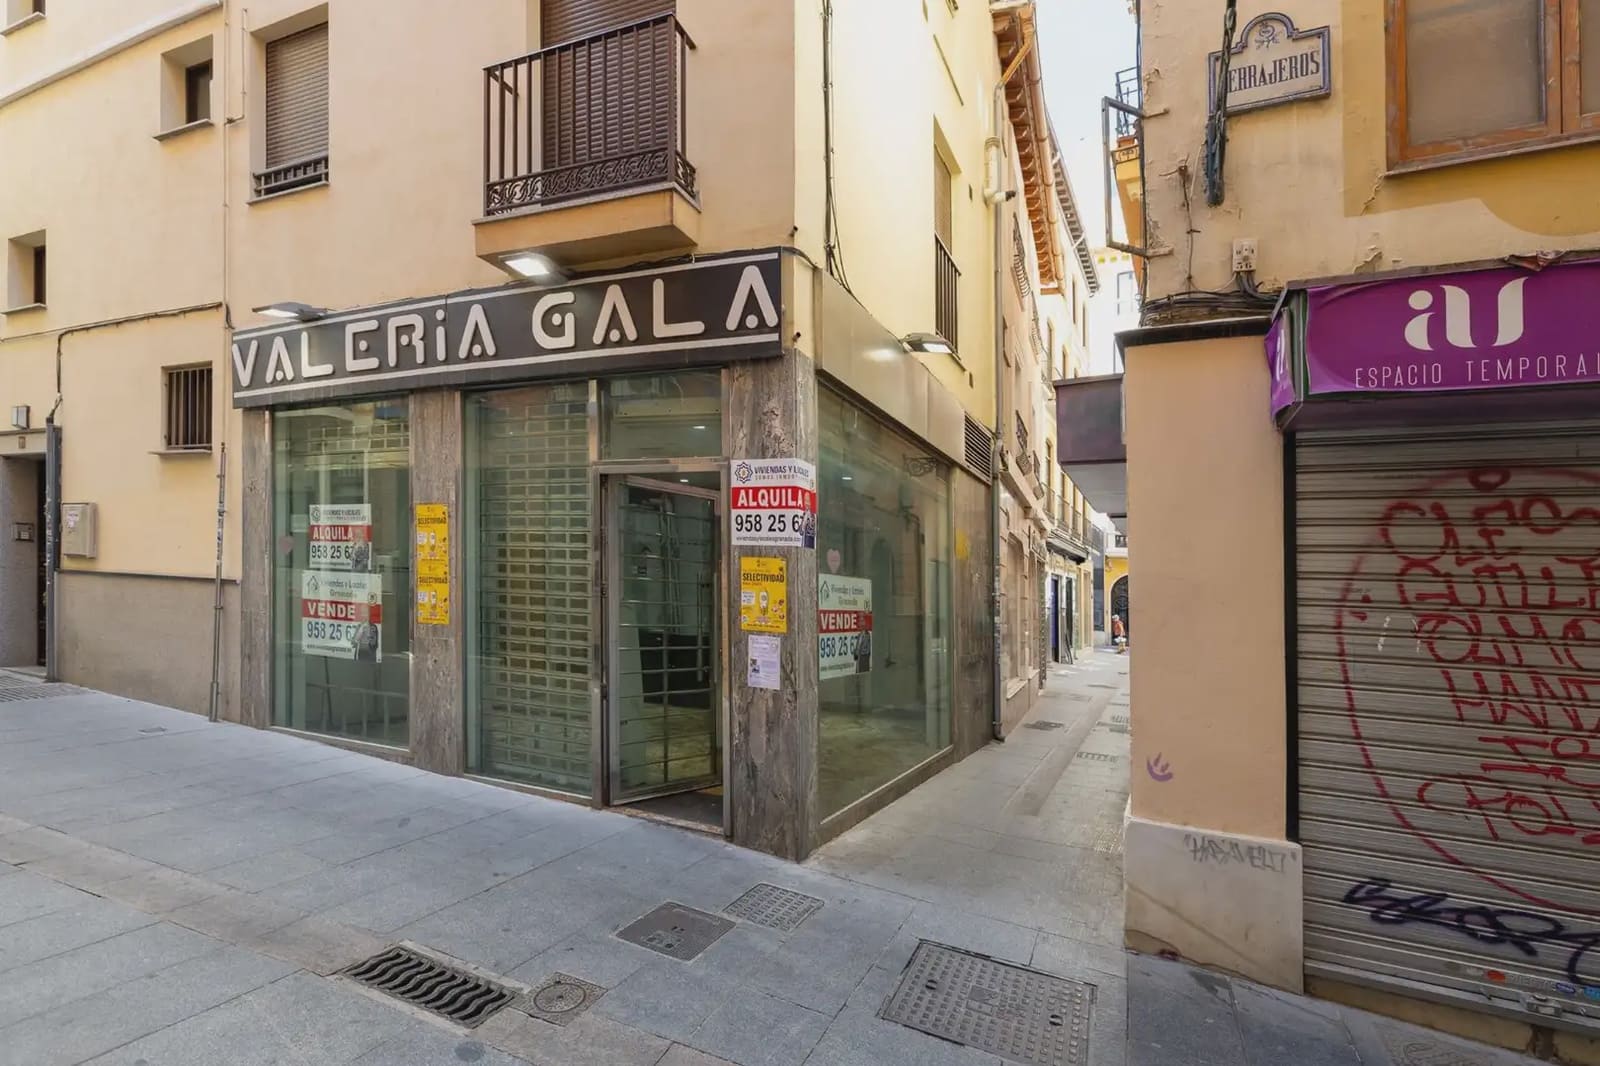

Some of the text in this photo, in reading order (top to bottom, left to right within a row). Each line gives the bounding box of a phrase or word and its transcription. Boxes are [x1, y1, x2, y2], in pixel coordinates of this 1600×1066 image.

[1226, 50, 1320, 93] ERRAJEROS
[532, 264, 779, 350] GALA
[1355, 363, 1442, 388] ESPACIO
[737, 488, 804, 507] ALQUILA
[735, 513, 762, 533] 958
[767, 514, 787, 533] 25
[312, 526, 354, 540] ALQUILA
[311, 545, 328, 559] 958
[330, 545, 342, 559] 25
[742, 572, 785, 584] SELECTIVIDAD
[307, 602, 356, 619] VENDE
[307, 621, 326, 639] 958
[329, 623, 342, 640] 25
[820, 612, 858, 631] VENDE
[820, 637, 836, 658] 958
[838, 636, 849, 656] 25
